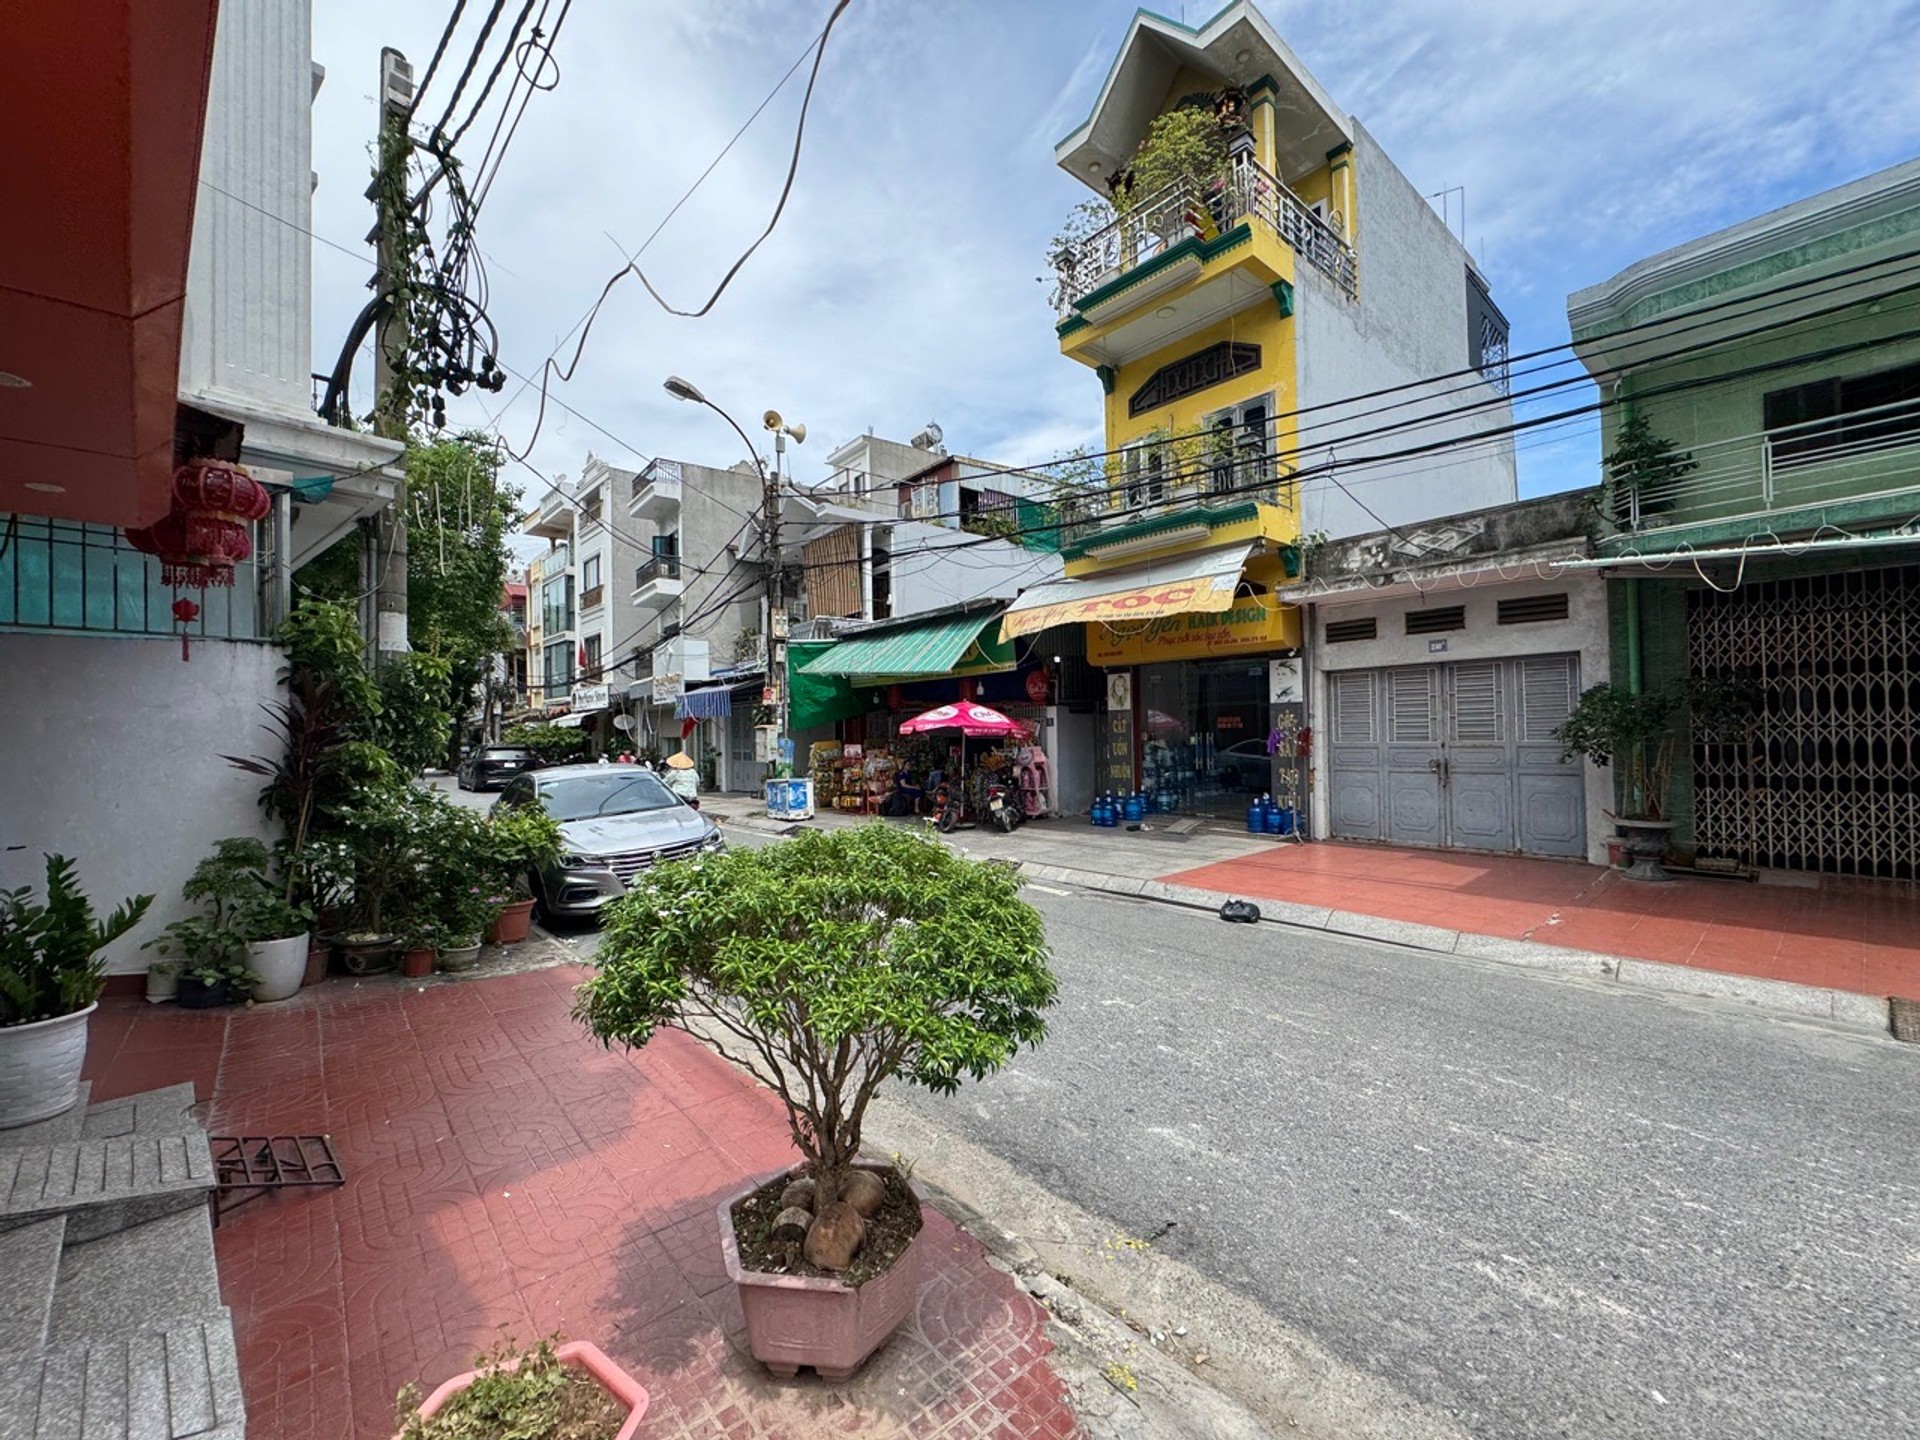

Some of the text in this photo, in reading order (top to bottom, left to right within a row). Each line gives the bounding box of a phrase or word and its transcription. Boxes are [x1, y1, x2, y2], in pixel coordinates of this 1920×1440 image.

[1080, 587, 1195, 612] TÓC
[1188, 612, 1218, 630] HAIR
[1221, 607, 1267, 627] DESIGN
